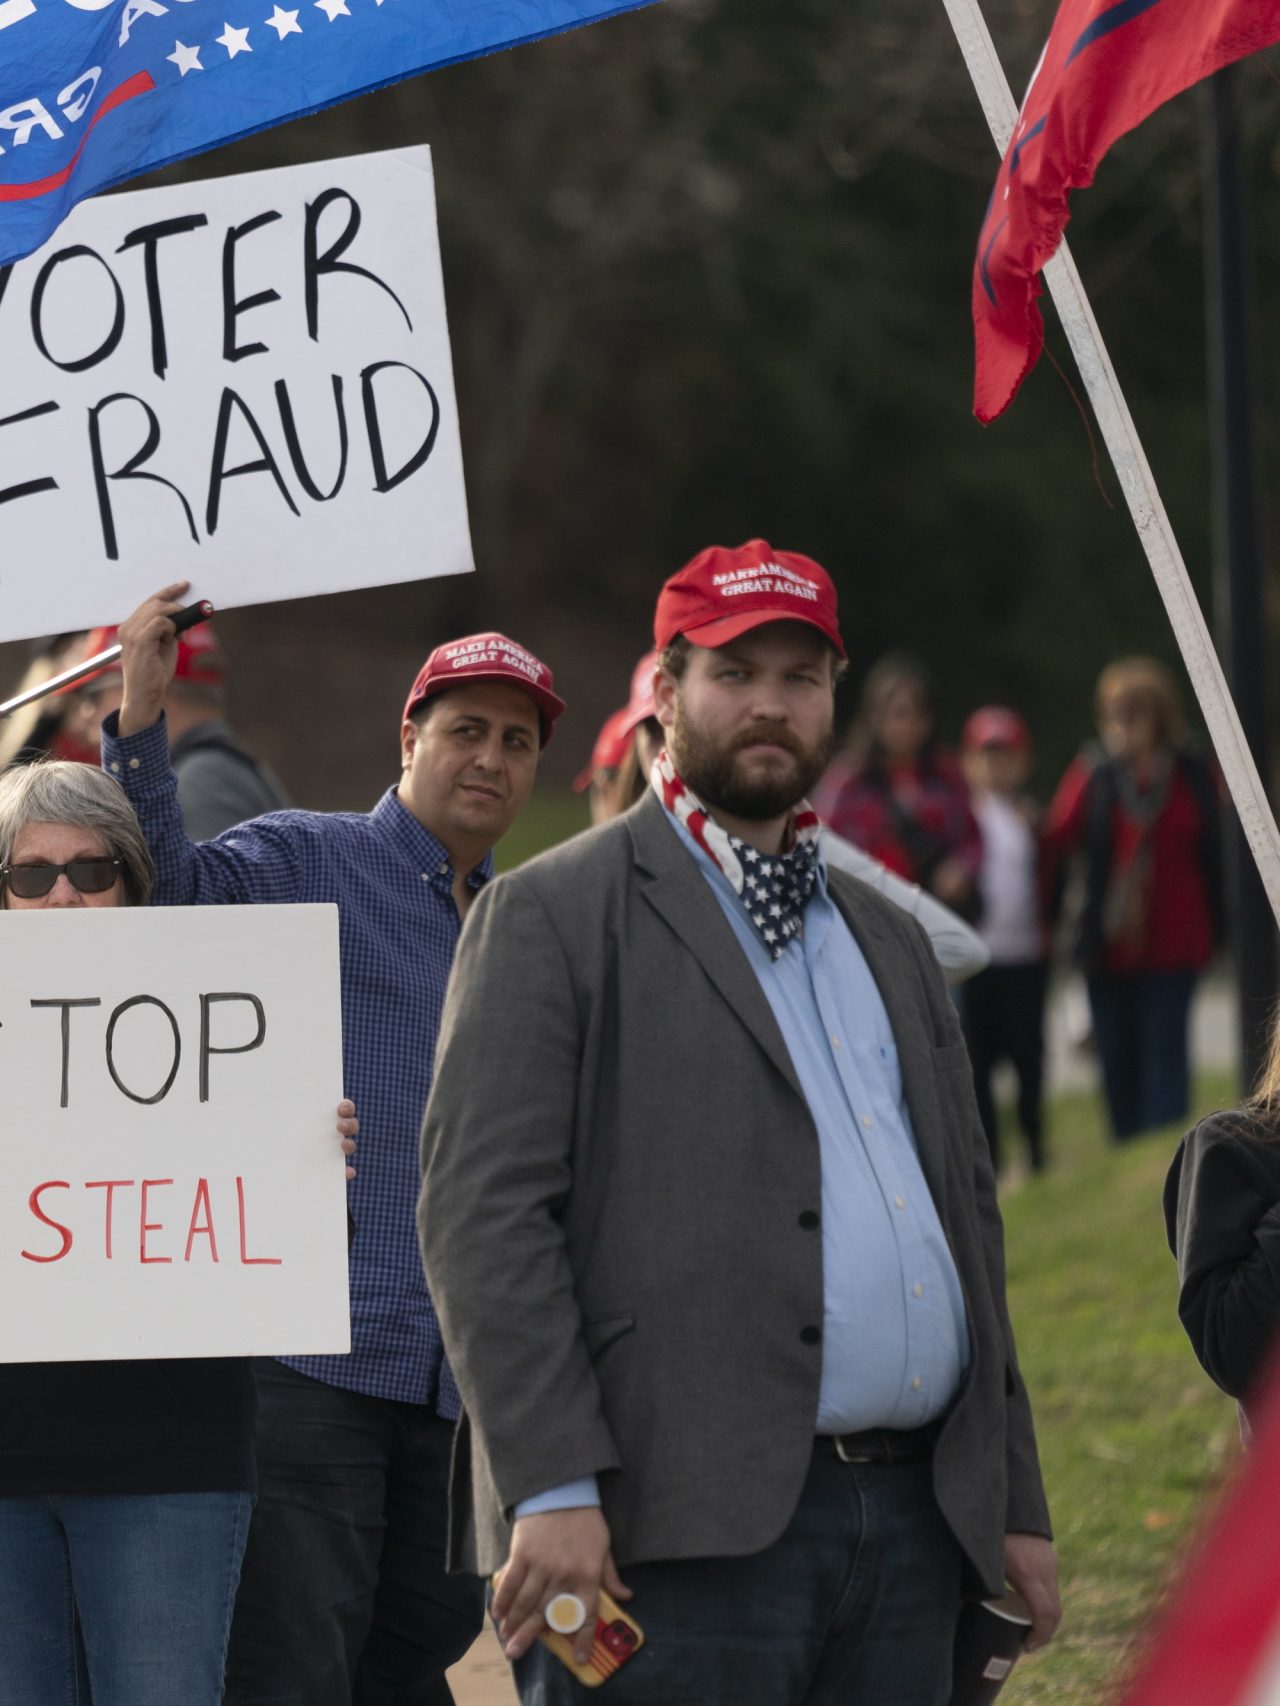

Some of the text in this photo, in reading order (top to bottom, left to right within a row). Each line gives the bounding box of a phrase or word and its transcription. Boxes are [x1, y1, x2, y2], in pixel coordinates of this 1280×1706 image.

[712, 561, 821, 590] MAKE AMERICA
[721, 577, 818, 602] GREAT AGAIN
[445, 640, 544, 675] MAKE AMERICA
[452, 650, 540, 685] GREAT AGAIN
[19, 1175, 283, 1265] STEAL
